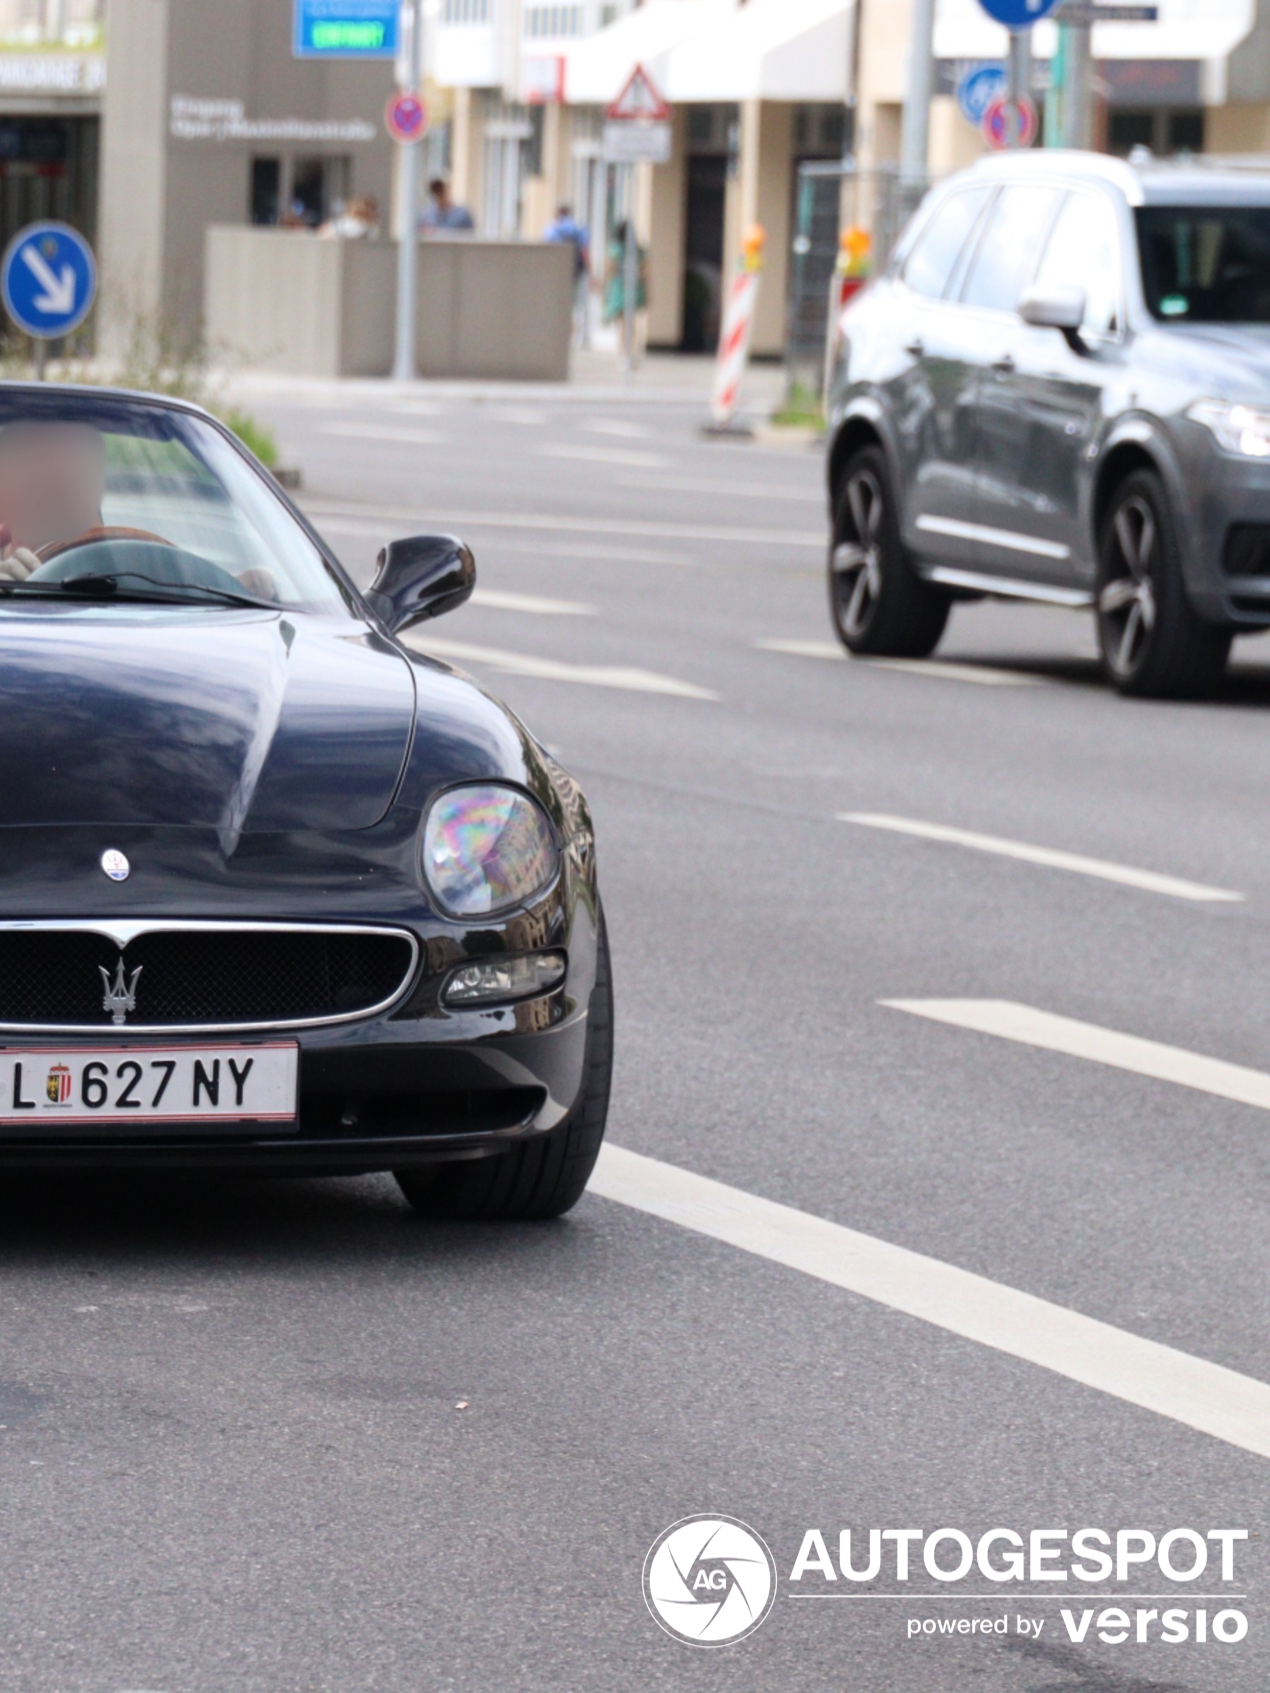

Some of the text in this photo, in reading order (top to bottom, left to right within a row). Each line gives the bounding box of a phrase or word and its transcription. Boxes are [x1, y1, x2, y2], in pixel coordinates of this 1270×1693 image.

[13, 1057, 254, 1109] L 627 NY
